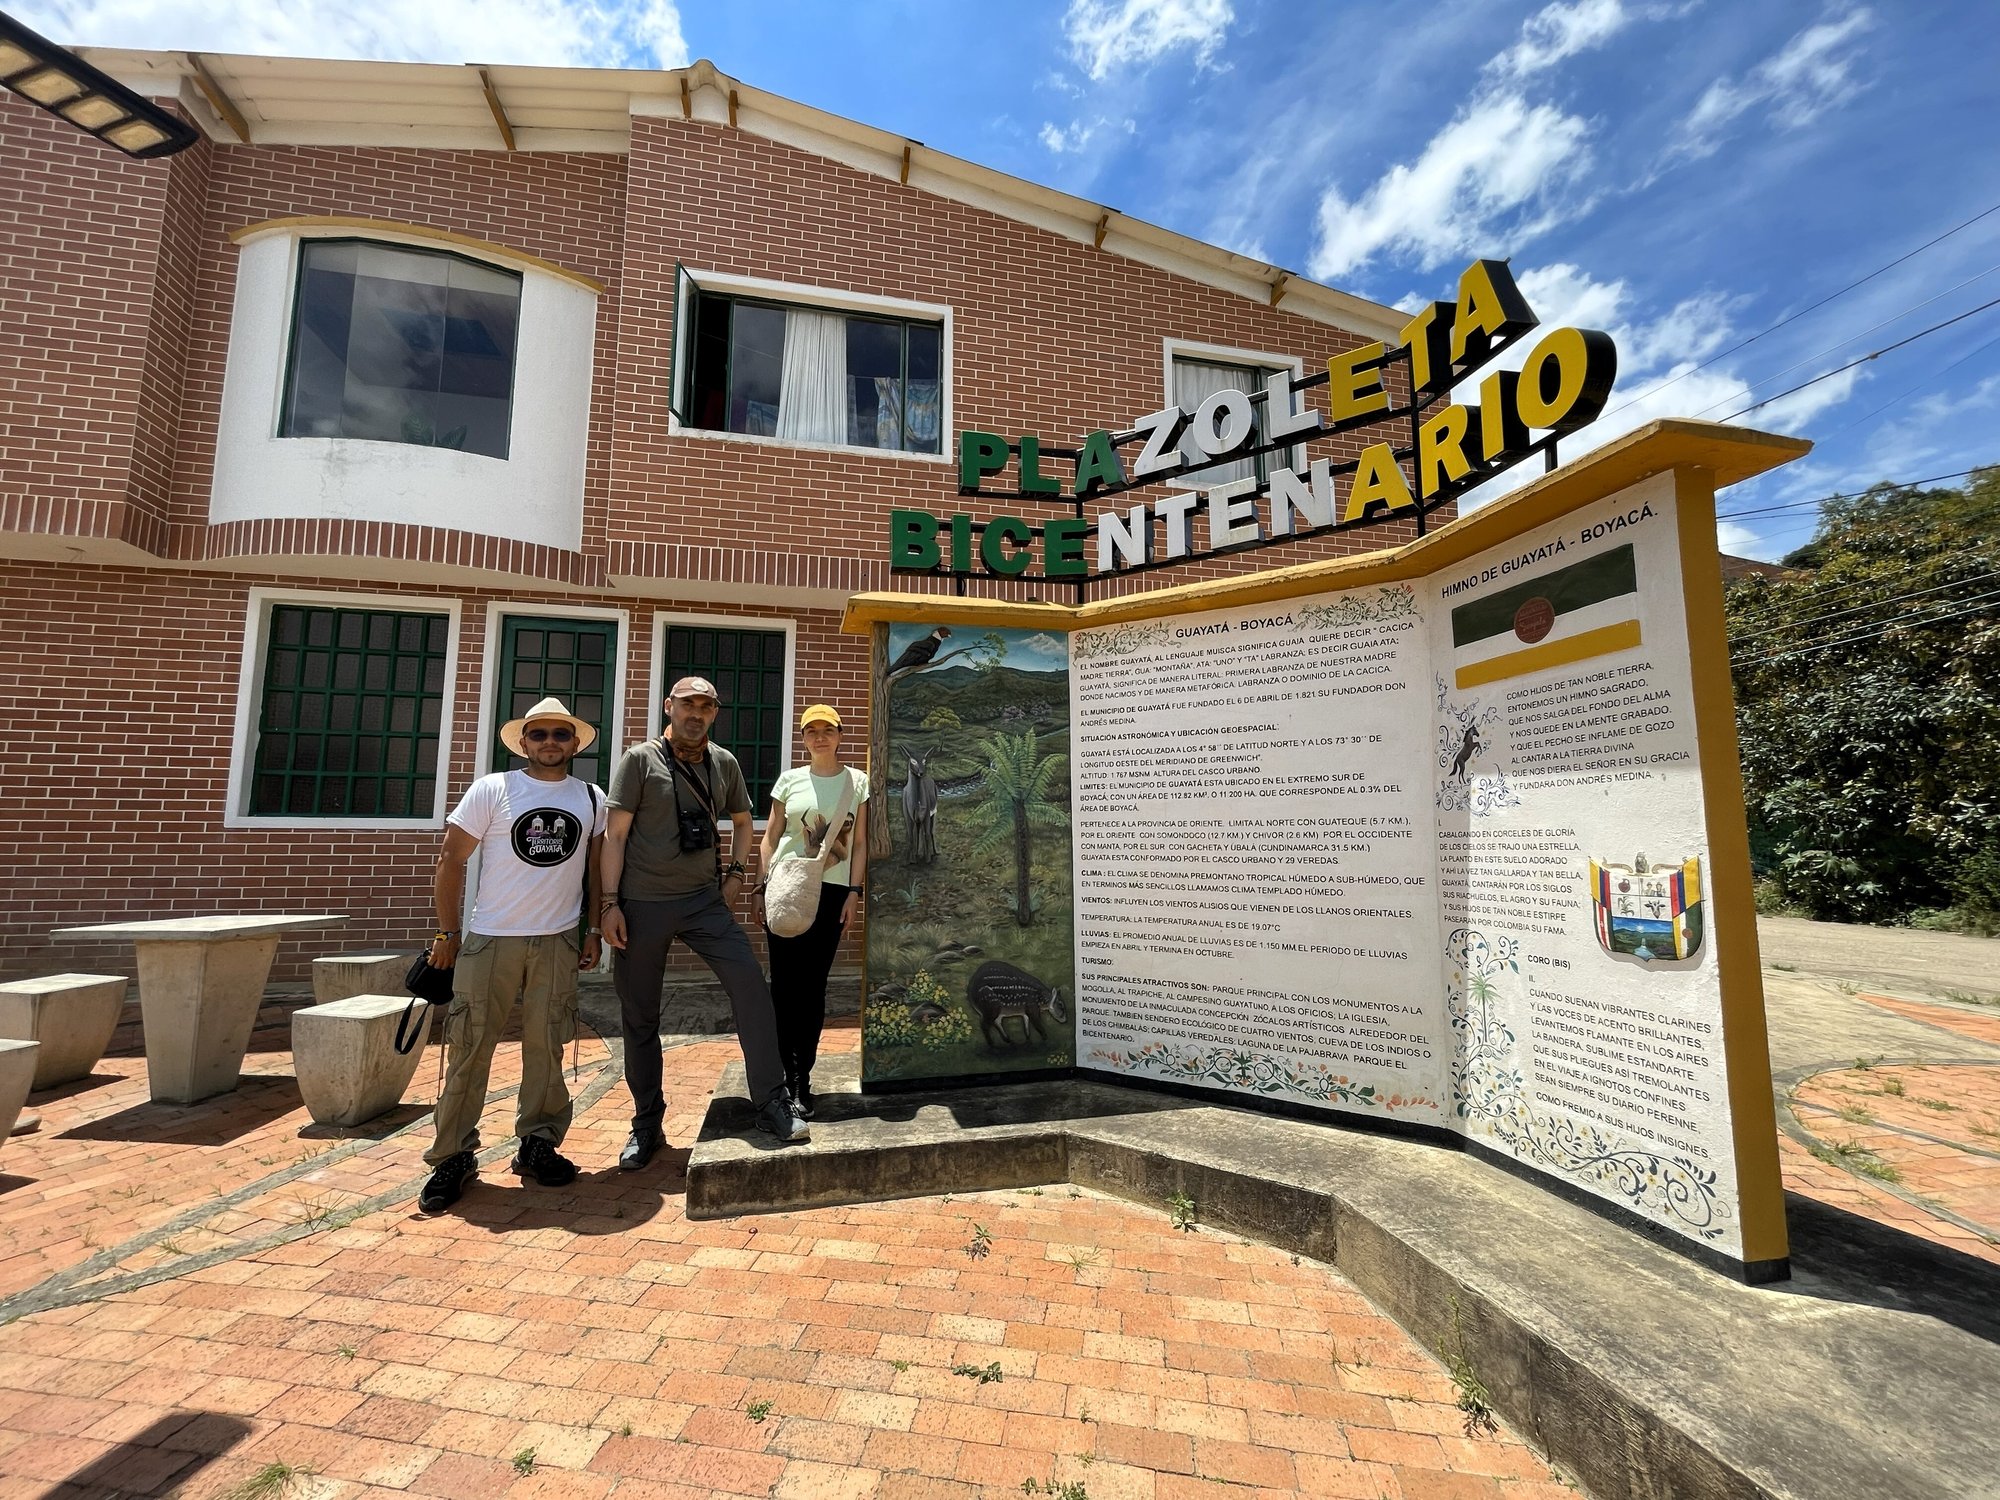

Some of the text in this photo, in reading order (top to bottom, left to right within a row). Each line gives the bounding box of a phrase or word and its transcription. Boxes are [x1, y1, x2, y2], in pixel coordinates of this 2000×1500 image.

[959, 259, 1539, 498] PLAZOLETA
[891, 327, 1617, 577] BICENTENARIO
[1442, 575, 1478, 599] HIMNO
[1481, 566, 1498, 583] DE
[1501, 536, 1566, 574] GUAYATÁ
[1581, 505, 1658, 544] BOYACÁ.
[1176, 621, 1230, 638] GUAYATÁ
[1090, 707, 1125, 715] MUNICIPIO
[1137, 702, 1171, 712] GUAYATÁ
[1188, 698, 1225, 708] FUNDADO
[1244, 696, 1255, 704] DE
[1256, 694, 1280, 702] ABRIL
[1281, 692, 1292, 701] DE
[1318, 689, 1330, 697] SU
[1332, 684, 1383, 696] FUNDADOR
[1385, 682, 1406, 691] DON
[1506, 689, 1529, 700] COMO
[1530, 684, 1553, 696] HIJOS
[1554, 681, 1566, 691] DE
[1567, 678, 1584, 687] TAN
[1585, 670, 1616, 684] NOBLE
[1507, 697, 1555, 713] ENTONEMOS
[1556, 695, 1568, 704] UN
[1570, 688, 1598, 701] HIMNO
[1508, 690, 1671, 726] QUE NOS SALGA DEL FONDO DEL ALMA
[1080, 717, 1108, 727] ANDRÉS
[1080, 734, 1116, 743] SITUACIÓN
[1117, 731, 1170, 740] ASTRONÓMICA
[1177, 727, 1219, 737] UBICACIÓN
[1516, 728, 1532, 738] NOS
[1532, 724, 1560, 735] QUEDE
[1562, 722, 1574, 731] EN
[1575, 720, 1587, 729] LA
[1587, 714, 1618, 727] MENTE
[1516, 741, 1533, 751] QUE
[1534, 740, 1544, 749] EL
[1544, 736, 1573, 747] PECHO
[1574, 734, 1586, 743] SE
[1588, 727, 1627, 741] INFLAME
[1629, 725, 1642, 735] DE
[1645, 720, 1675, 733] GOZO
[1512, 751, 1690, 778] QUE NOS DIERA EL SEÑOR EN SU GRACIA
[1521, 752, 1552, 764] CANTAR
[1552, 752, 1559, 760] A
[1559, 751, 1570, 759] LA
[1571, 746, 1603, 757] TIERRA
[1604, 742, 1635, 754] DIVINA
[1512, 783, 1518, 791] Y
[1519, 780, 1556, 790] FUNDARA
[1556, 778, 1575, 787] DON
[1576, 774, 1612, 785] ANDRÉS
[1080, 804, 1098, 812] ÁREA
[526, 836, 564, 846] TERRITORIO
[1438, 828, 1576, 839] CABALGANDO EN CORCELES DE GLORIA
[1114, 898, 1148, 906] INFLUYEN
[1149, 899, 1164, 907] LOS
[1165, 900, 1198, 908] VIENTOS
[1199, 902, 1229, 910] ALISIOS
[1230, 903, 1248, 911] QUE
[1250, 904, 1280, 912] VIENEN
[1282, 906, 1294, 914] DE
[1296, 906, 1314, 914] LOS
[1315, 907, 1351, 916] LLANOS
[1528, 954, 1571, 970] CORO (BIS)
[1096, 974, 1142, 984] PRINCIPALES
[1142, 978, 1189, 989] ATRACTIVOS
[1212, 985, 1244, 996] PARQUE
[1246, 989, 1290, 1000] PRINCIPAL
[1291, 993, 1310, 1003] CON
[1312, 996, 1330, 1005] LOS
[1332, 998, 1400, 1013] MONUMENTOS
[1410, 1007, 1423, 1015] LA
[1529, 988, 1711, 1034] CUANDO SUENAN VIBRANTES CLARINES
[1531, 1016, 1709, 1067] LEVANTEMOS FLAMANTE EN LOS AIRES
[1533, 1044, 1710, 1102] QUE SUS PLIEGUES ASÍ TREMOLANTES
[1534, 1058, 1686, 1112] EN EL VIAJE A IGNOTOS CONFINES
[1535, 1072, 1556, 1086] SEAN
[1558, 1079, 1596, 1099] SIEMPRE
[1597, 1092, 1610, 1103] SU
[1612, 1096, 1645, 1115] DIARIO
[1536, 1091, 1561, 1106] COMO
[1562, 1100, 1596, 1118] PREMIO
[1597, 1112, 1604, 1122] A
[1605, 1115, 1624, 1129] SUS
[1626, 1122, 1654, 1140] HIJOS
